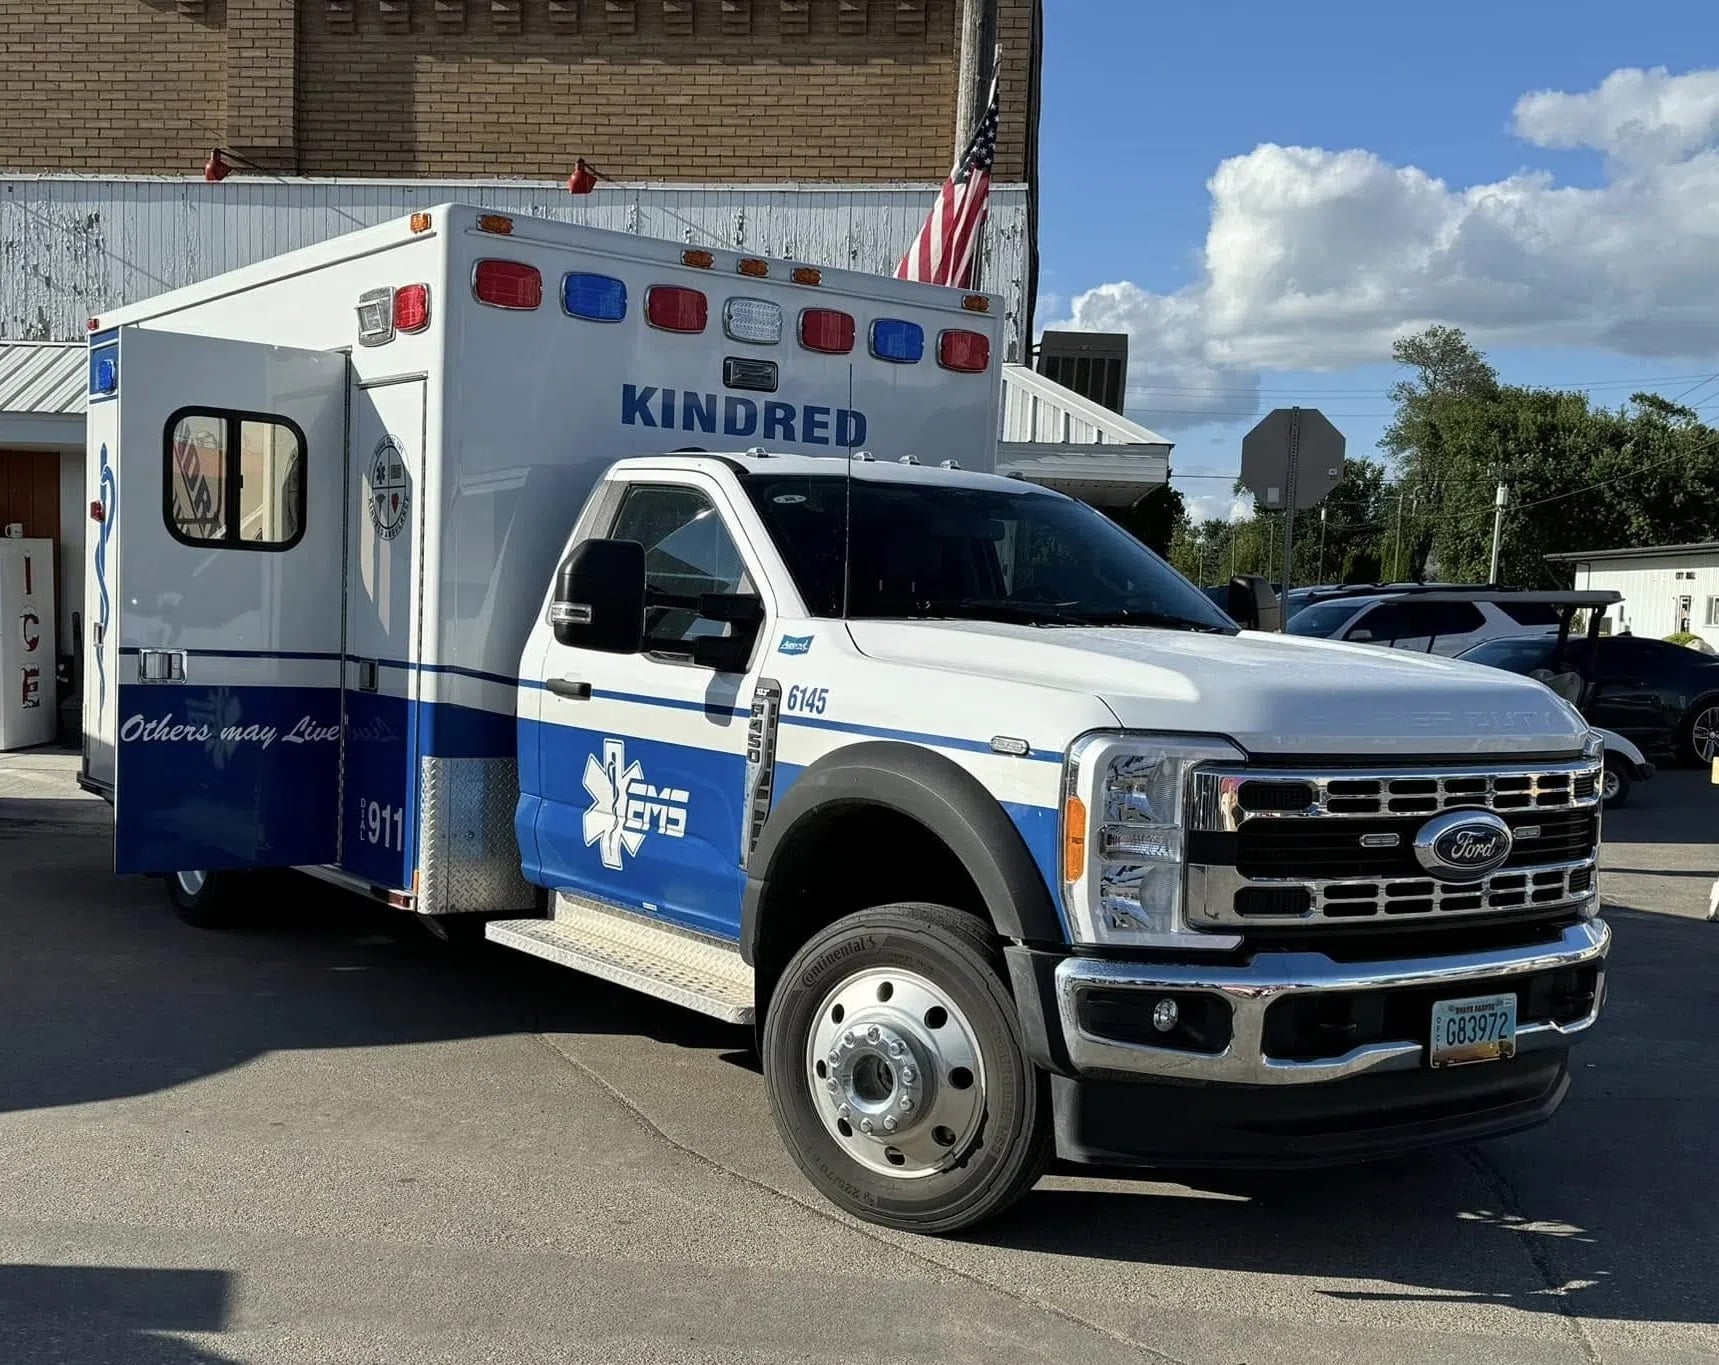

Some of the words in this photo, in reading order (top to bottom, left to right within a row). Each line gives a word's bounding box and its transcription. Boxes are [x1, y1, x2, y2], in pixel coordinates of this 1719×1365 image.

[621, 383, 867, 448] KINDRED
[20, 551, 40, 709] ICE
[787, 684, 829, 714] 6145
[120, 712, 212, 743] Others
[219, 723, 279, 750] may
[281, 714, 340, 744] Live
[368, 801, 403, 852] 911
[624, 780, 690, 839] EMS
[1451, 830, 1496, 859] Ford
[801, 937, 866, 988] Continental
[1446, 1011, 1509, 1046] G83972
